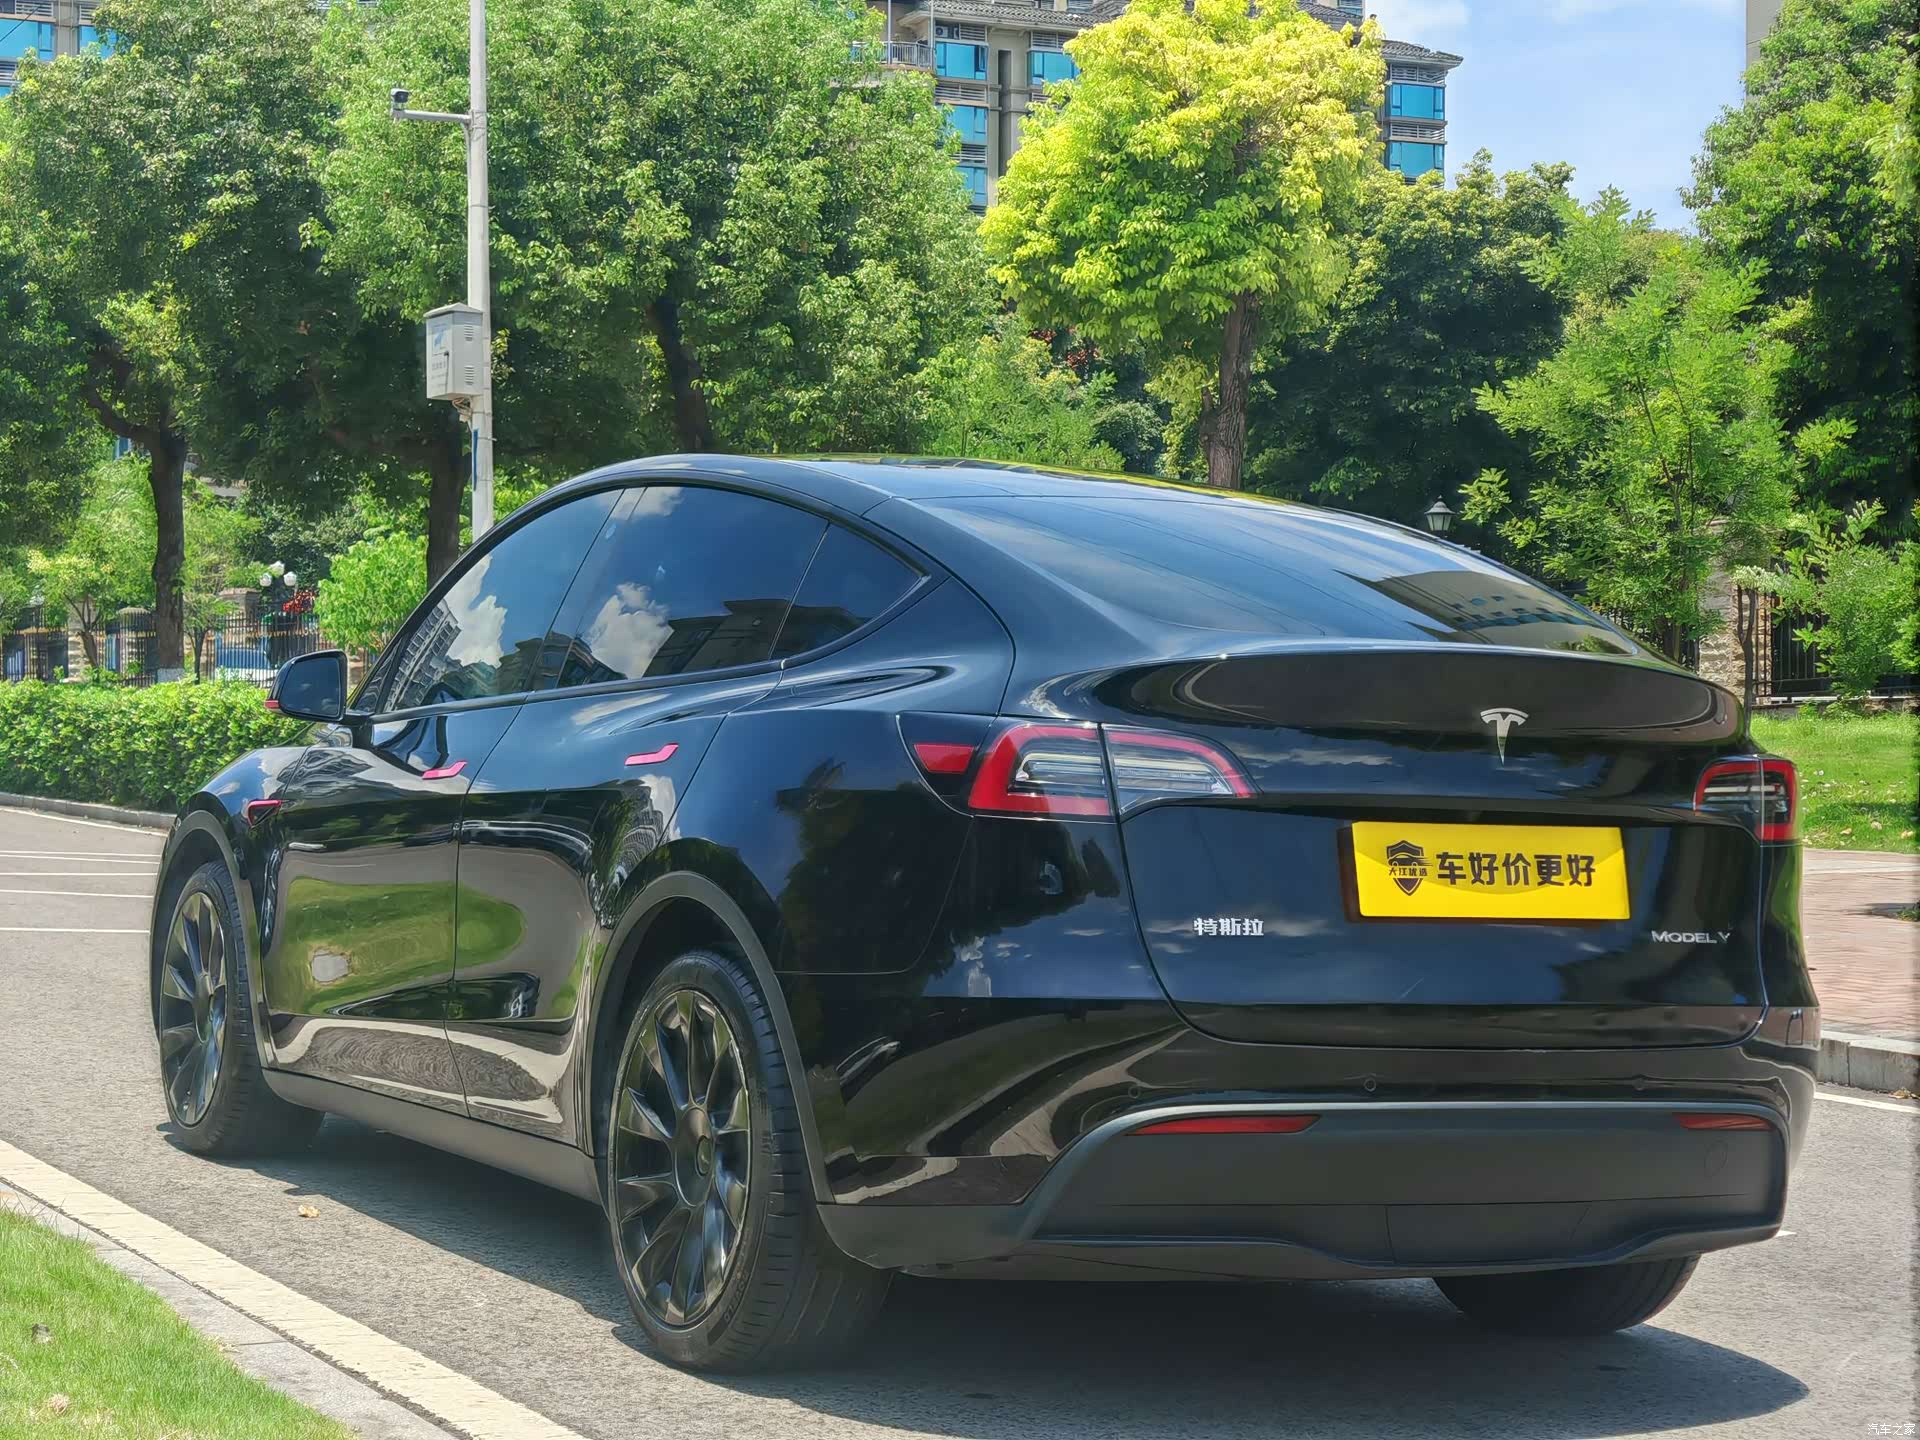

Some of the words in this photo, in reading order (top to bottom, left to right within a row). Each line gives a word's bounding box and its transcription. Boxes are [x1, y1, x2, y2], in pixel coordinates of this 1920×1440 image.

[1436, 852, 1596, 887] 车好价更好
[1193, 917, 1265, 936] 特斯拉
[1651, 930, 1718, 944] MODEL
[1717, 931, 1731, 943] Y
